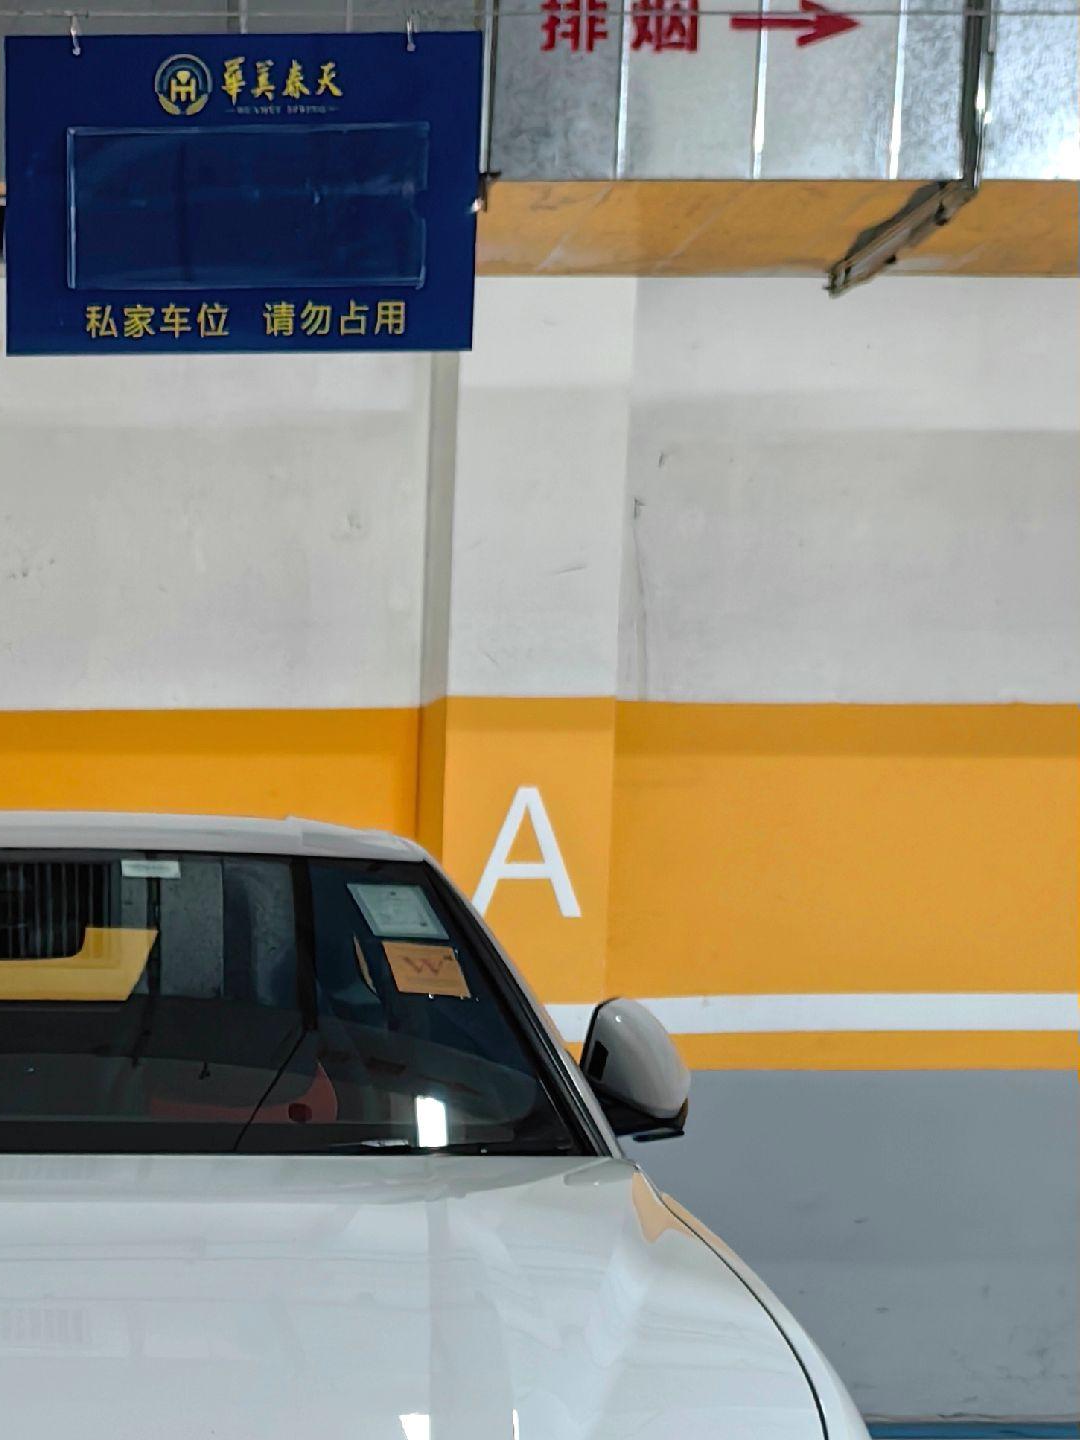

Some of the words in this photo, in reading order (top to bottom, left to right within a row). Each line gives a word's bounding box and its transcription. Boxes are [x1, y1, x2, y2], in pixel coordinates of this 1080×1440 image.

[85, 303, 230, 338] 私家车位
[262, 300, 406, 336] 请勿占用
[471, 786, 582, 917] A
